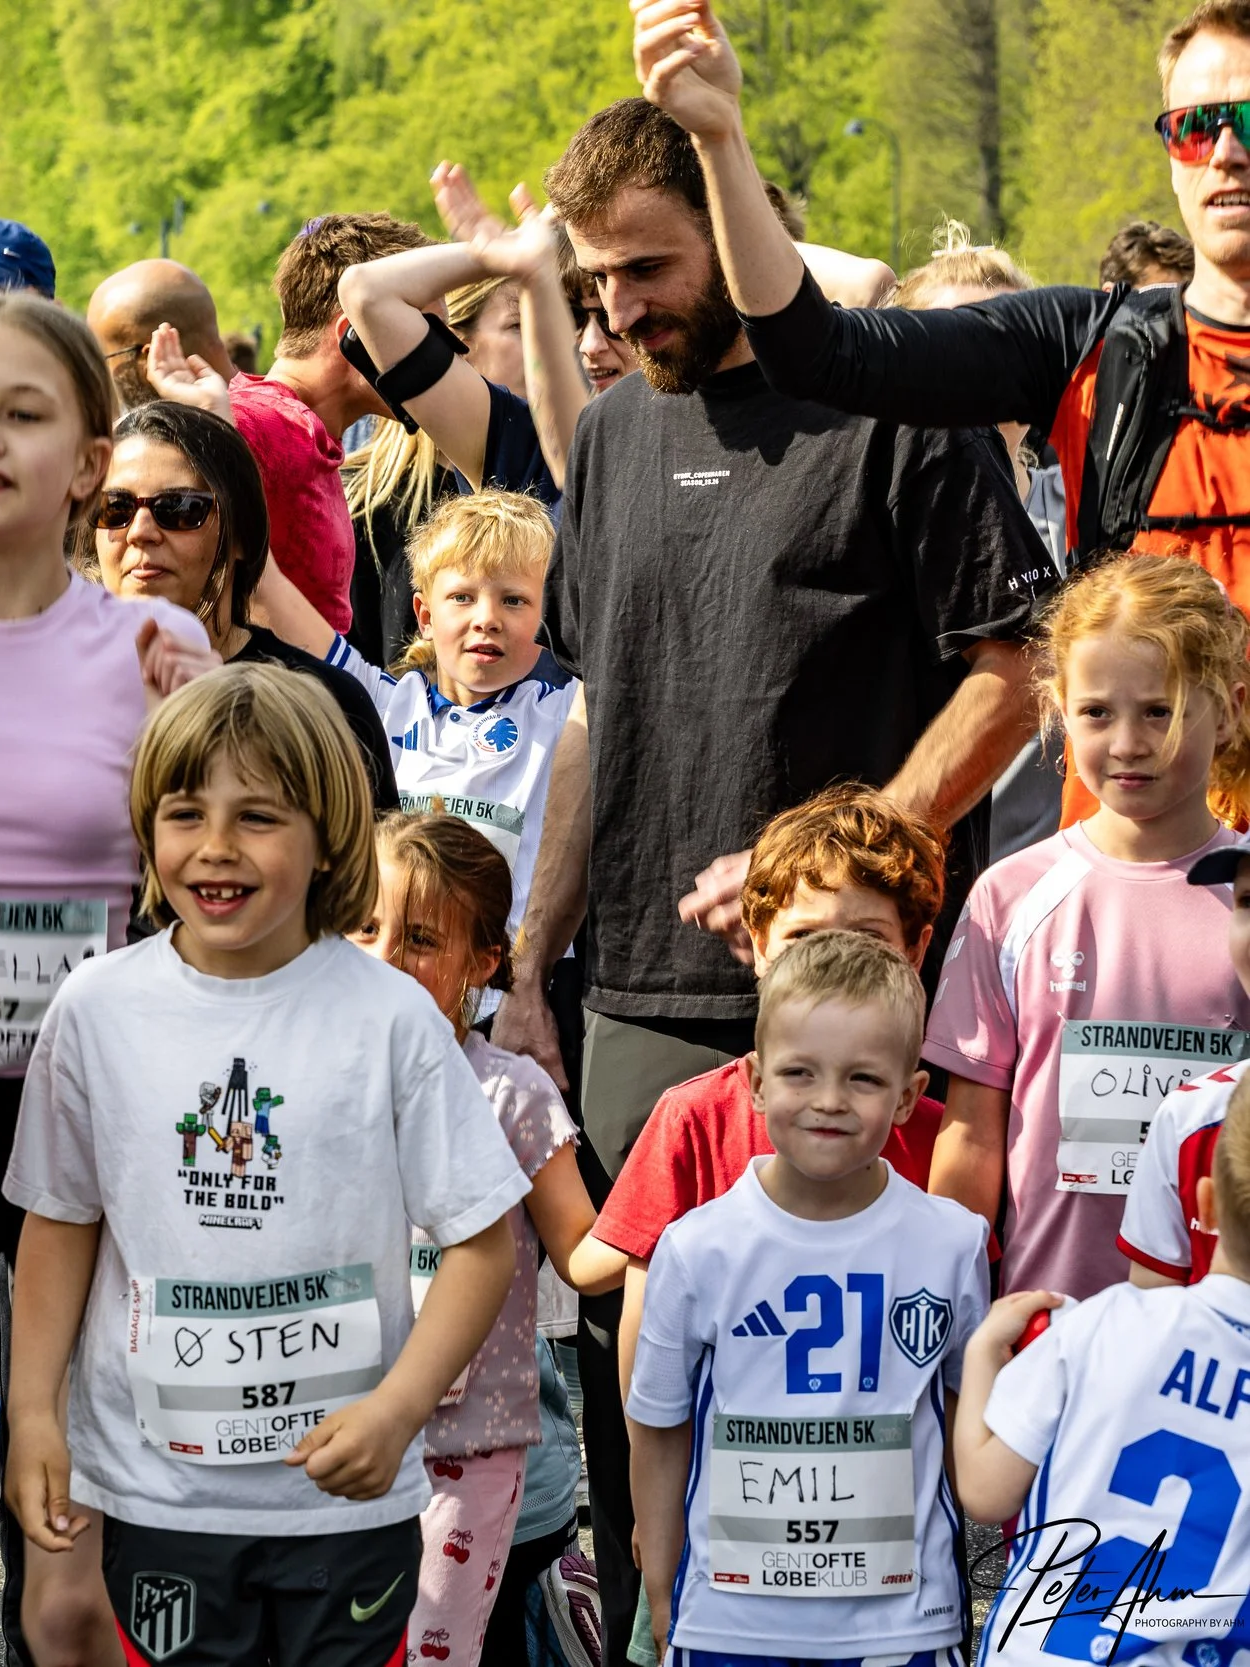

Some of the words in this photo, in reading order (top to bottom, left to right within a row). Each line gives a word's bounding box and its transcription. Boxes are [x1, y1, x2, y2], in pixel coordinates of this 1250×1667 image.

[1008, 566, 1051, 590] HYOX
[476, 801, 495, 820] 5K
[1050, 979, 1087, 993] hummel
[1081, 1025, 1205, 1054] STRANDVEJEN
[1210, 1035, 1233, 1056] 5K
[241, 1175, 276, 1192] FOR
[184, 1189, 217, 1207] THE
[417, 1249, 440, 1271] 5K
[171, 1281, 300, 1310] STRANDVEJEN
[305, 1274, 329, 1301] 5K
[783, 1272, 884, 1394] 21
[242, 1381, 296, 1409] 587
[215, 1409, 326, 1436] GENTOFTE
[726, 1419, 848, 1445] STRANDVEJEN
[853, 1420, 876, 1443] 5K
[218, 1433, 305, 1455] LØBEKL
[740, 1460, 855, 1504] EMIL
[786, 1520, 839, 1543] 557
[761, 1551, 866, 1569] GENTOFTE
[762, 1570, 867, 1587] LØBEKLUB
